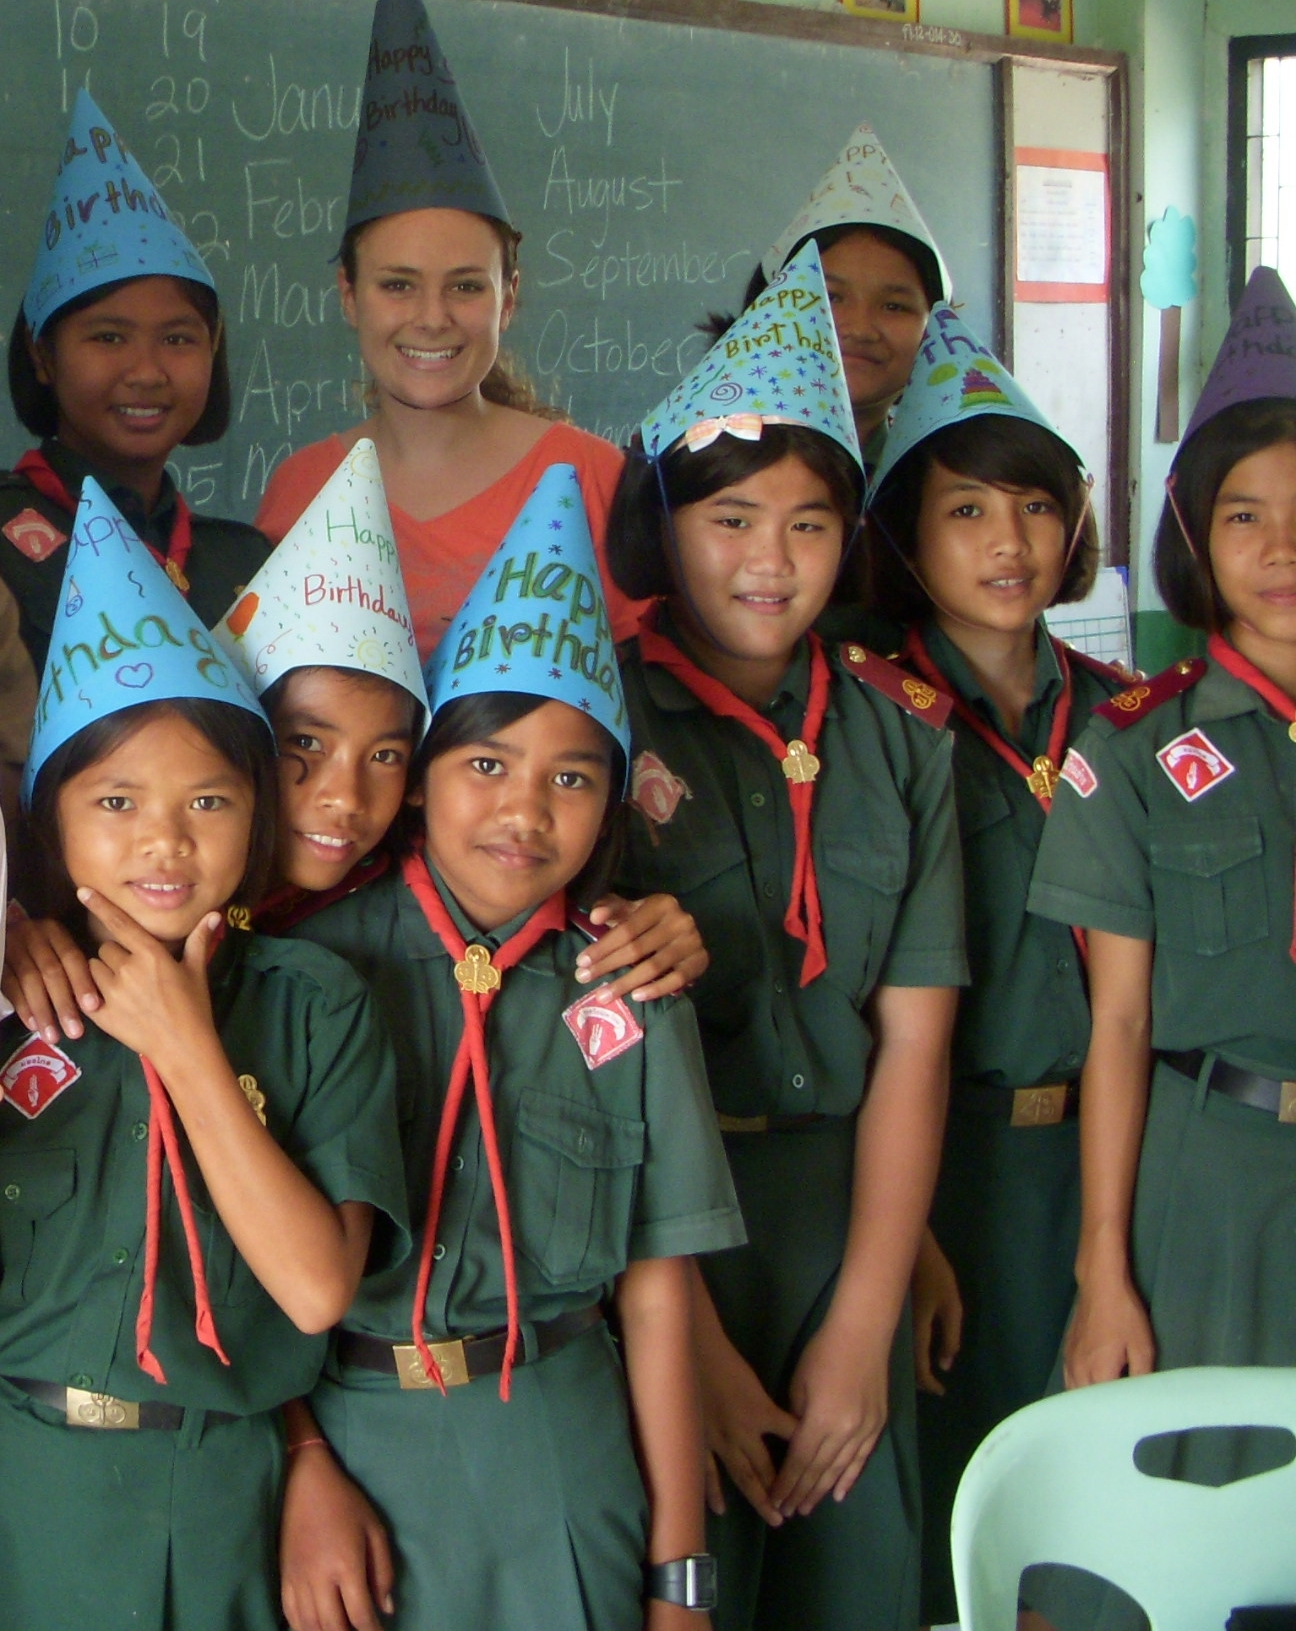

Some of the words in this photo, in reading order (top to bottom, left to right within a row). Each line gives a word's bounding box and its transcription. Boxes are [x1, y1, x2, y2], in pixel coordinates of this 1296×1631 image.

[56, 0, 98, 59] 10
[162, 0, 206, 62] 19
[146, 76, 209, 121] 20
[232, 54, 361, 141] Janu
[537, 46, 619, 146] July
[154, 134, 205, 188] 21
[544, 145, 683, 248] August
[245, 158, 346, 240] Febr
[538, 229, 751, 300] September
[537, 309, 708, 376] October
[239, 339, 368, 436] April
[326, 506, 402, 576] Happ
[304, 574, 415, 648] Birthday
